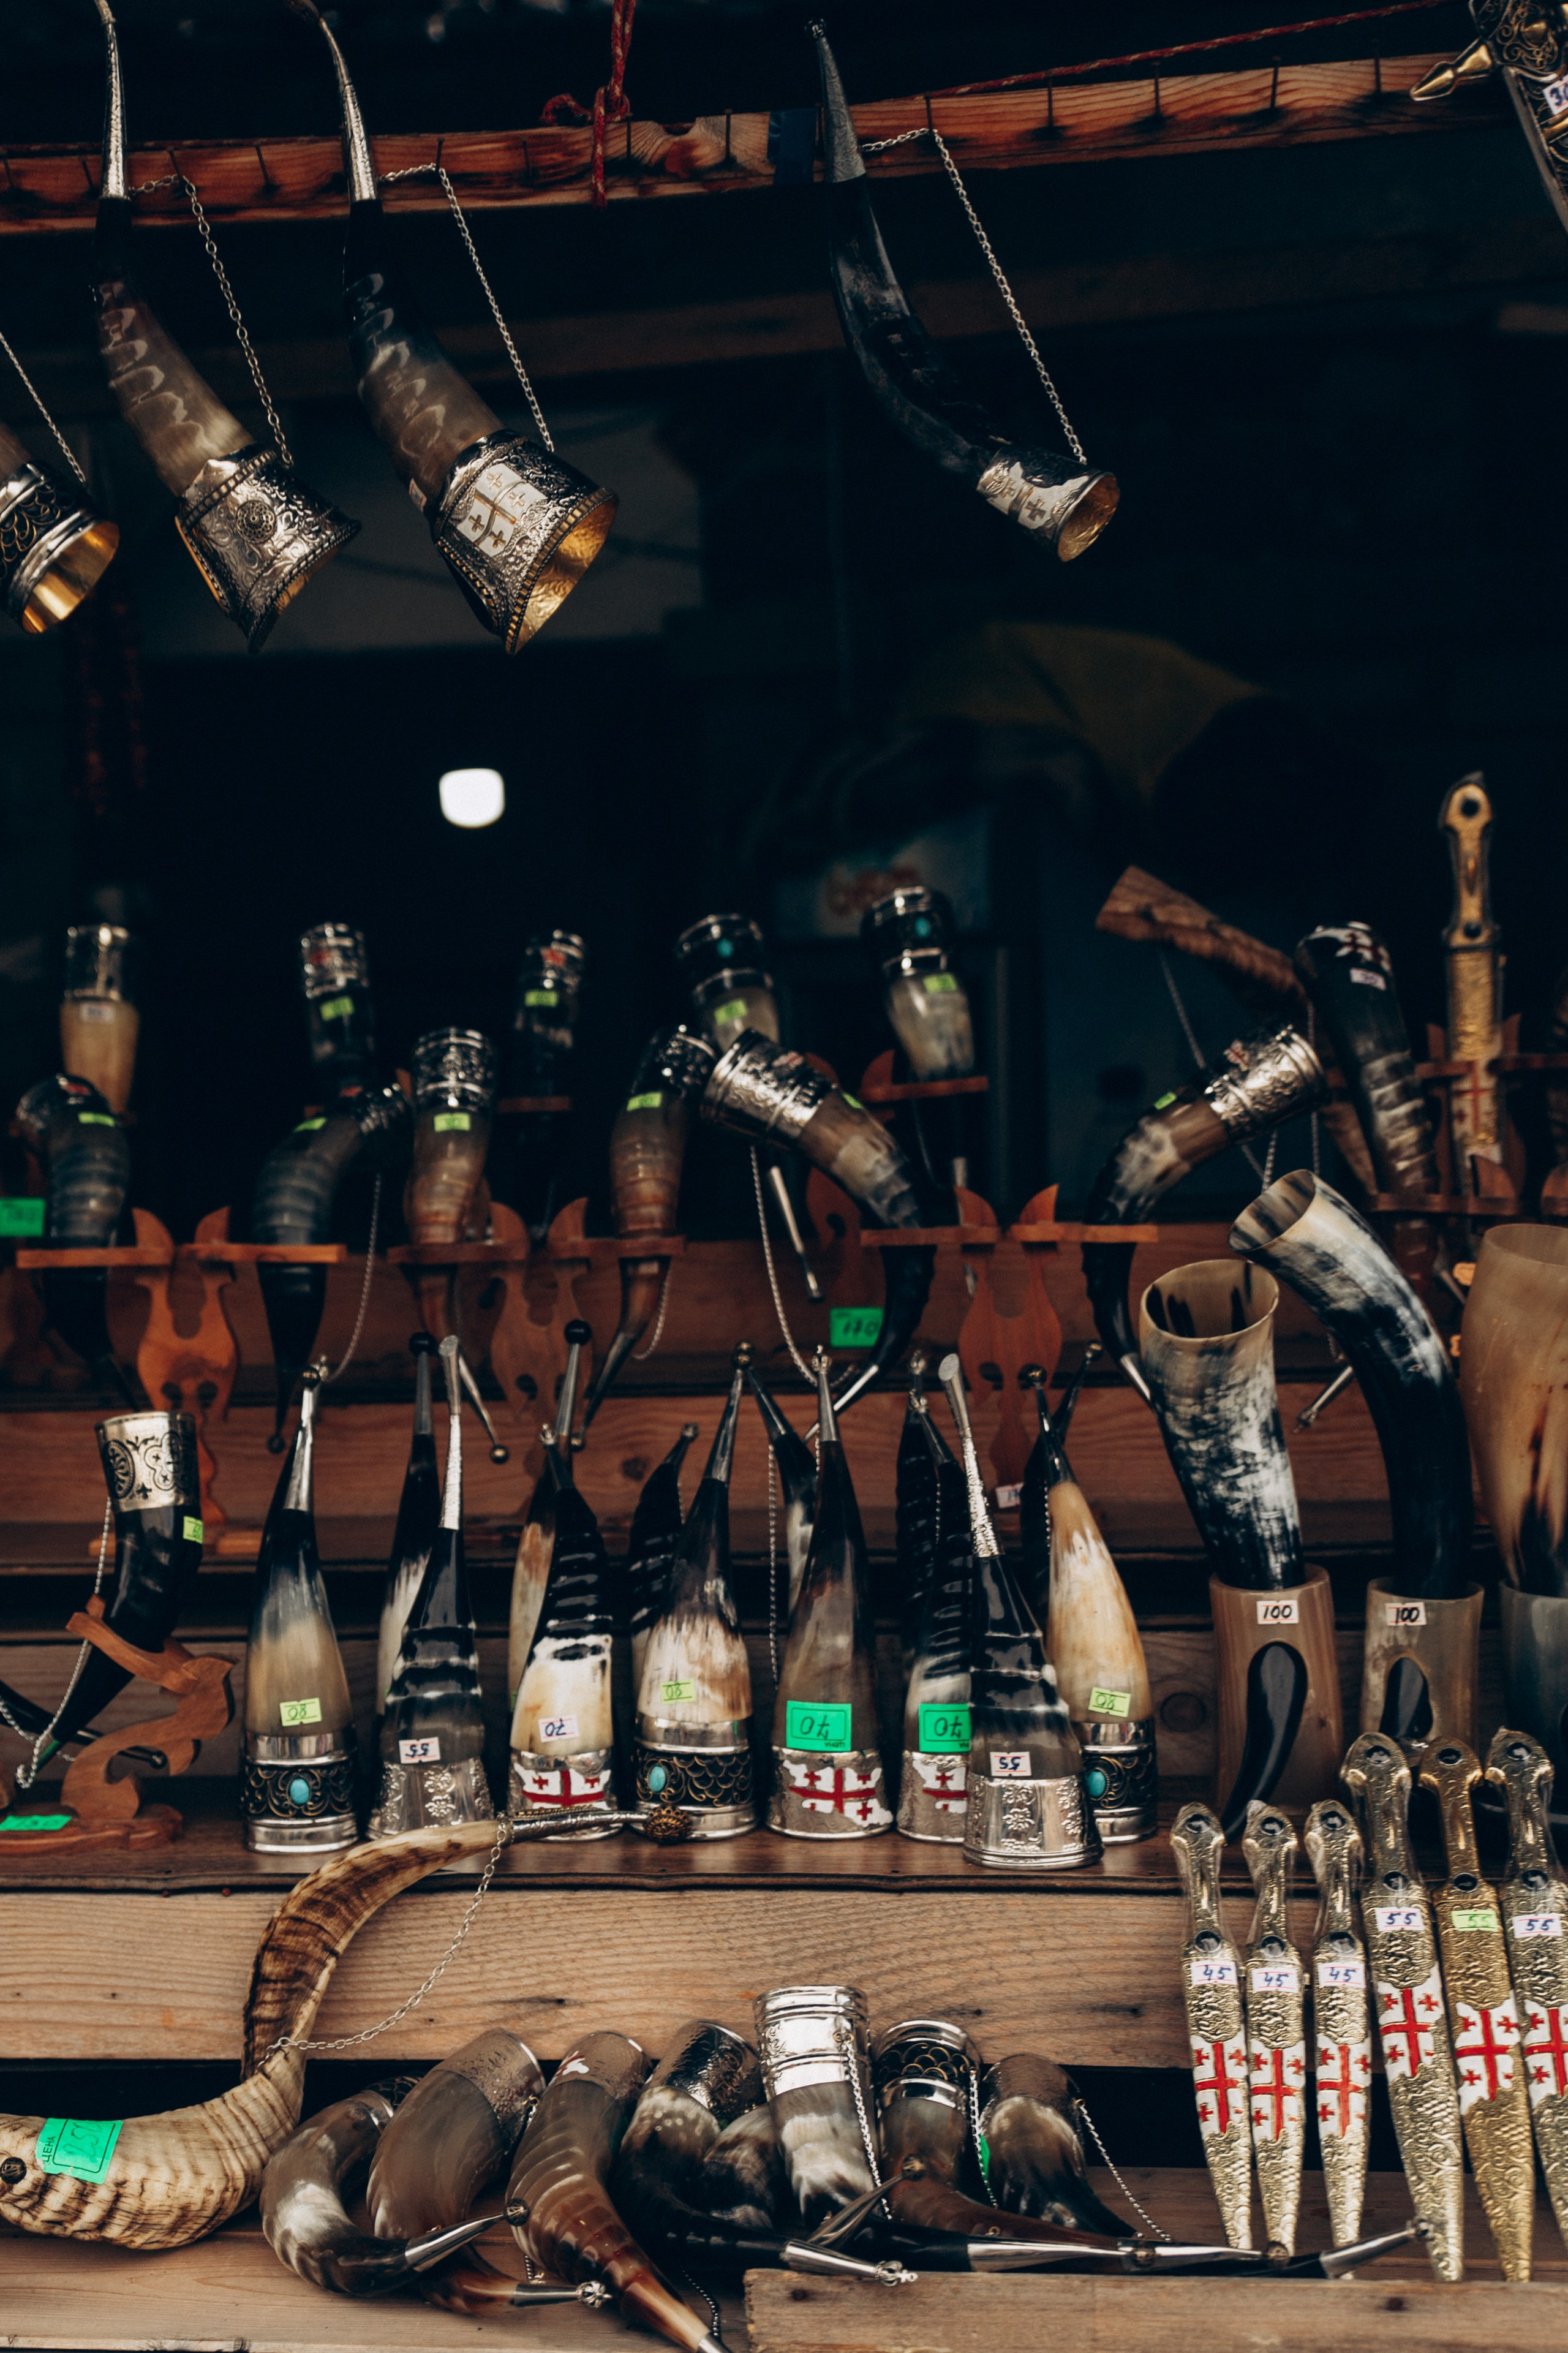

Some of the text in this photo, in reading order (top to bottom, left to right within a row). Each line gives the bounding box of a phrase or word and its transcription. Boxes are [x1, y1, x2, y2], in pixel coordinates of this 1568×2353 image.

[1264, 1605, 1292, 1619] 100
[1395, 1607, 1420, 1624] 100
[666, 1682, 682, 1700] 80
[288, 1704, 307, 1720] 80
[545, 1718, 567, 1737] 70
[800, 1715, 829, 1740] 70
[934, 1716, 962, 1738] 70
[405, 1743, 429, 1758] 55
[999, 1756, 1021, 1771] 55
[1386, 1913, 1417, 1925] 55
[1467, 1914, 1492, 1928] 55
[1525, 1919, 1554, 1931] 55
[1203, 1965, 1231, 1981] 45
[1264, 1972, 1289, 1987] 45
[1329, 1966, 1356, 1982] 45
[42, 2136, 56, 2165] ЦЕНА
